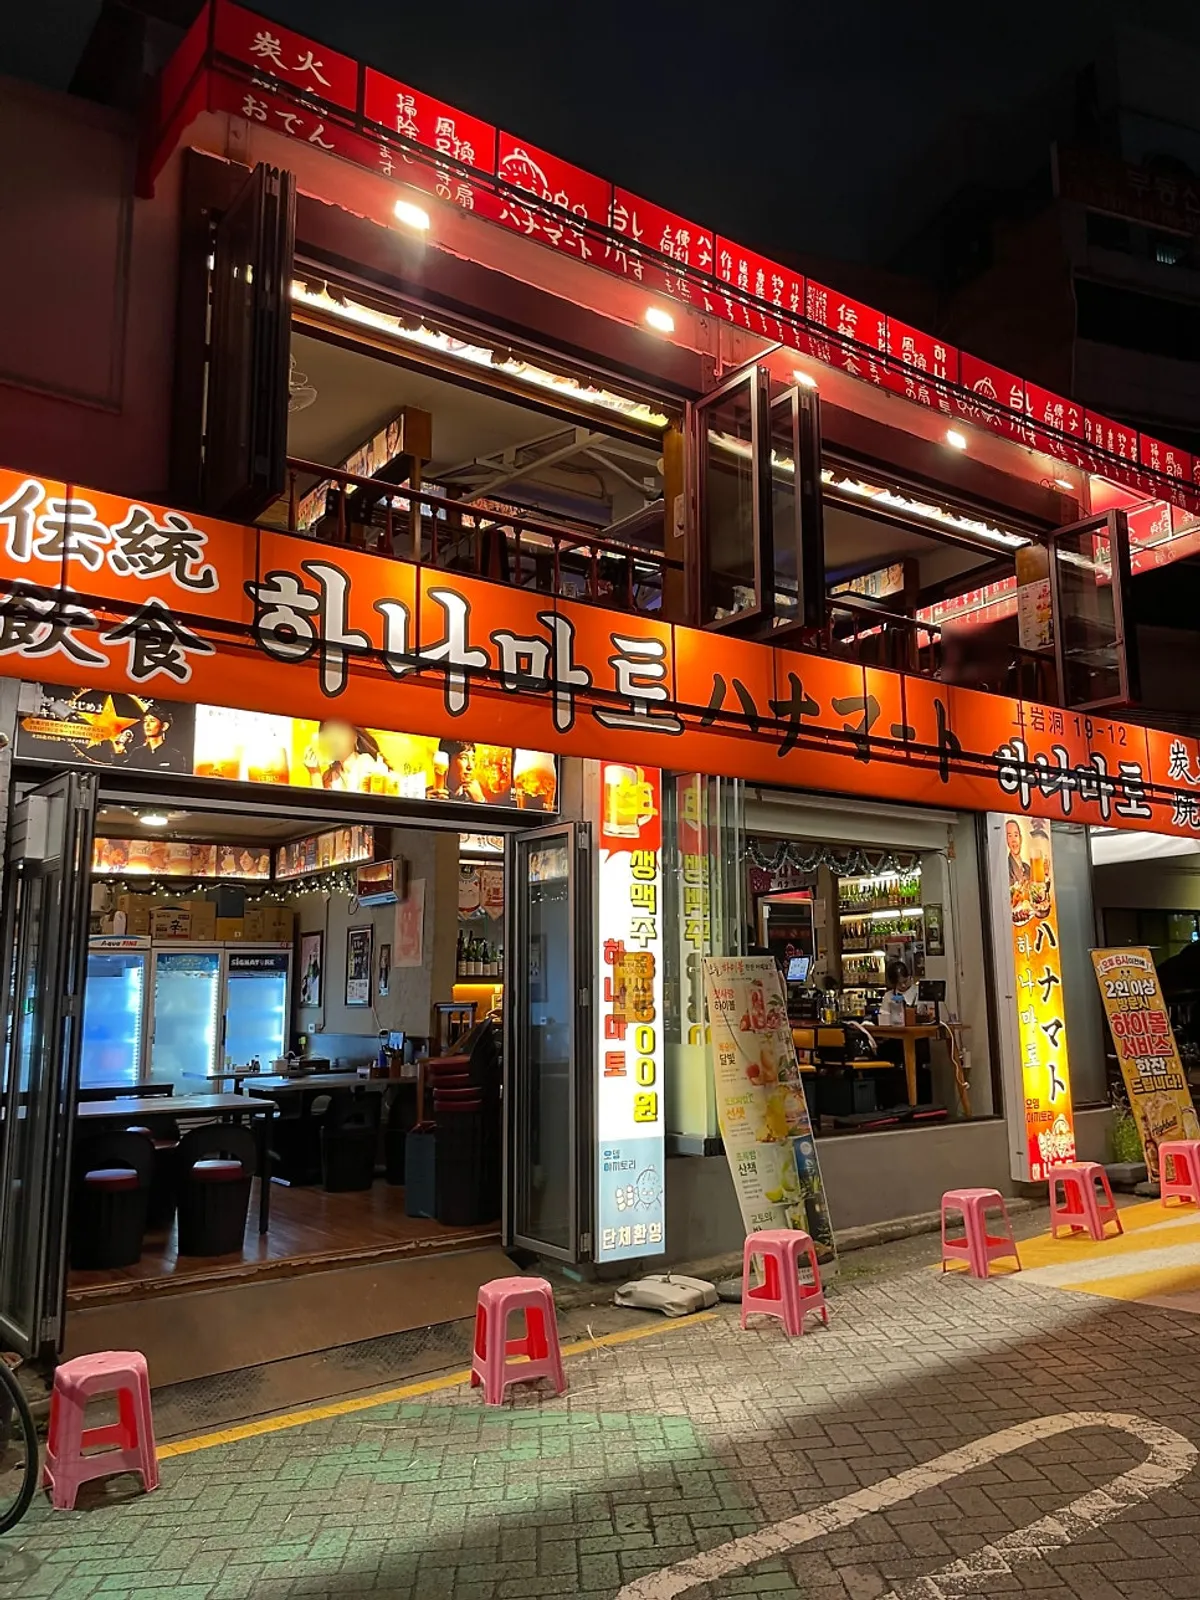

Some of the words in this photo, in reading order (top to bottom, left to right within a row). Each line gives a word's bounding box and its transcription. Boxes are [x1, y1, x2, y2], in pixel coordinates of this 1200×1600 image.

[249, 31, 331, 87] 炭火
[242, 94, 336, 149] おでん
[0, 479, 219, 592] 伝統
[0, 579, 216, 684] 飲食
[700, 672, 962, 784] ハナマート
[1011, 703, 1065, 736] 上岩洞
[1073, 716, 1127, 747] 19-12
[1167, 739, 1200, 785] 炭
[629, 850, 658, 948] 생맥주
[1111, 1010, 1169, 1037] 하이볼
[1121, 1034, 1175, 1060] 서비스
[1135, 1057, 1168, 1076] 한잔
[1131, 1073, 1184, 1095] 드립니다!
[738, 1162, 758, 1177] 산책
[602, 1223, 663, 1250] 단체환영
